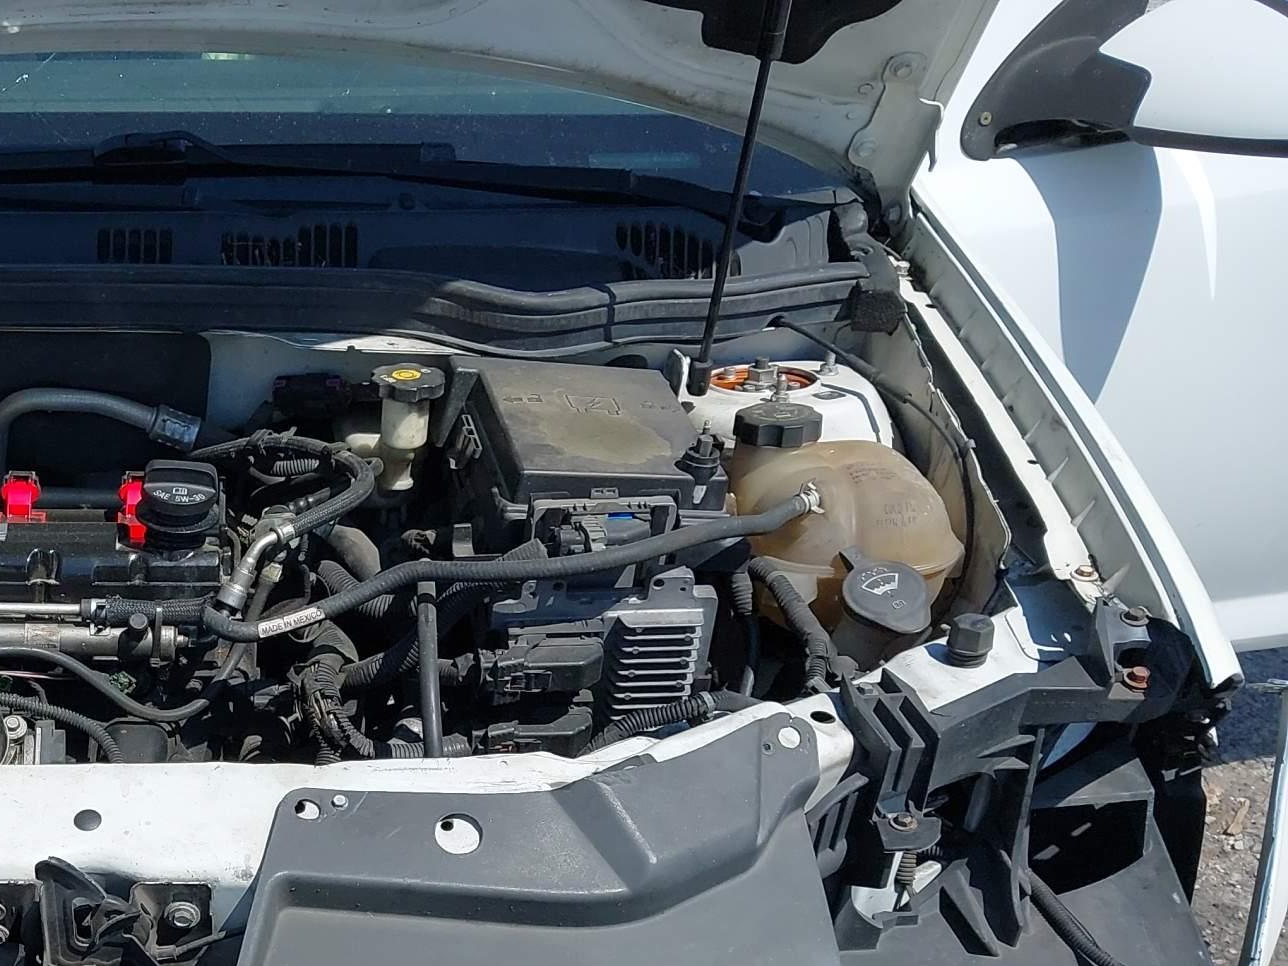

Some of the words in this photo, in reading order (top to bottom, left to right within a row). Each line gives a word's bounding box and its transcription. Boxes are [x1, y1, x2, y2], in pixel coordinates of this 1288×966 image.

[153, 489, 171, 500] SAE
[175, 493, 206, 503] 5W-30
[261, 622, 284, 635] MADE
[284, 618, 293, 629] IN
[294, 609, 323, 627] MEXICO
